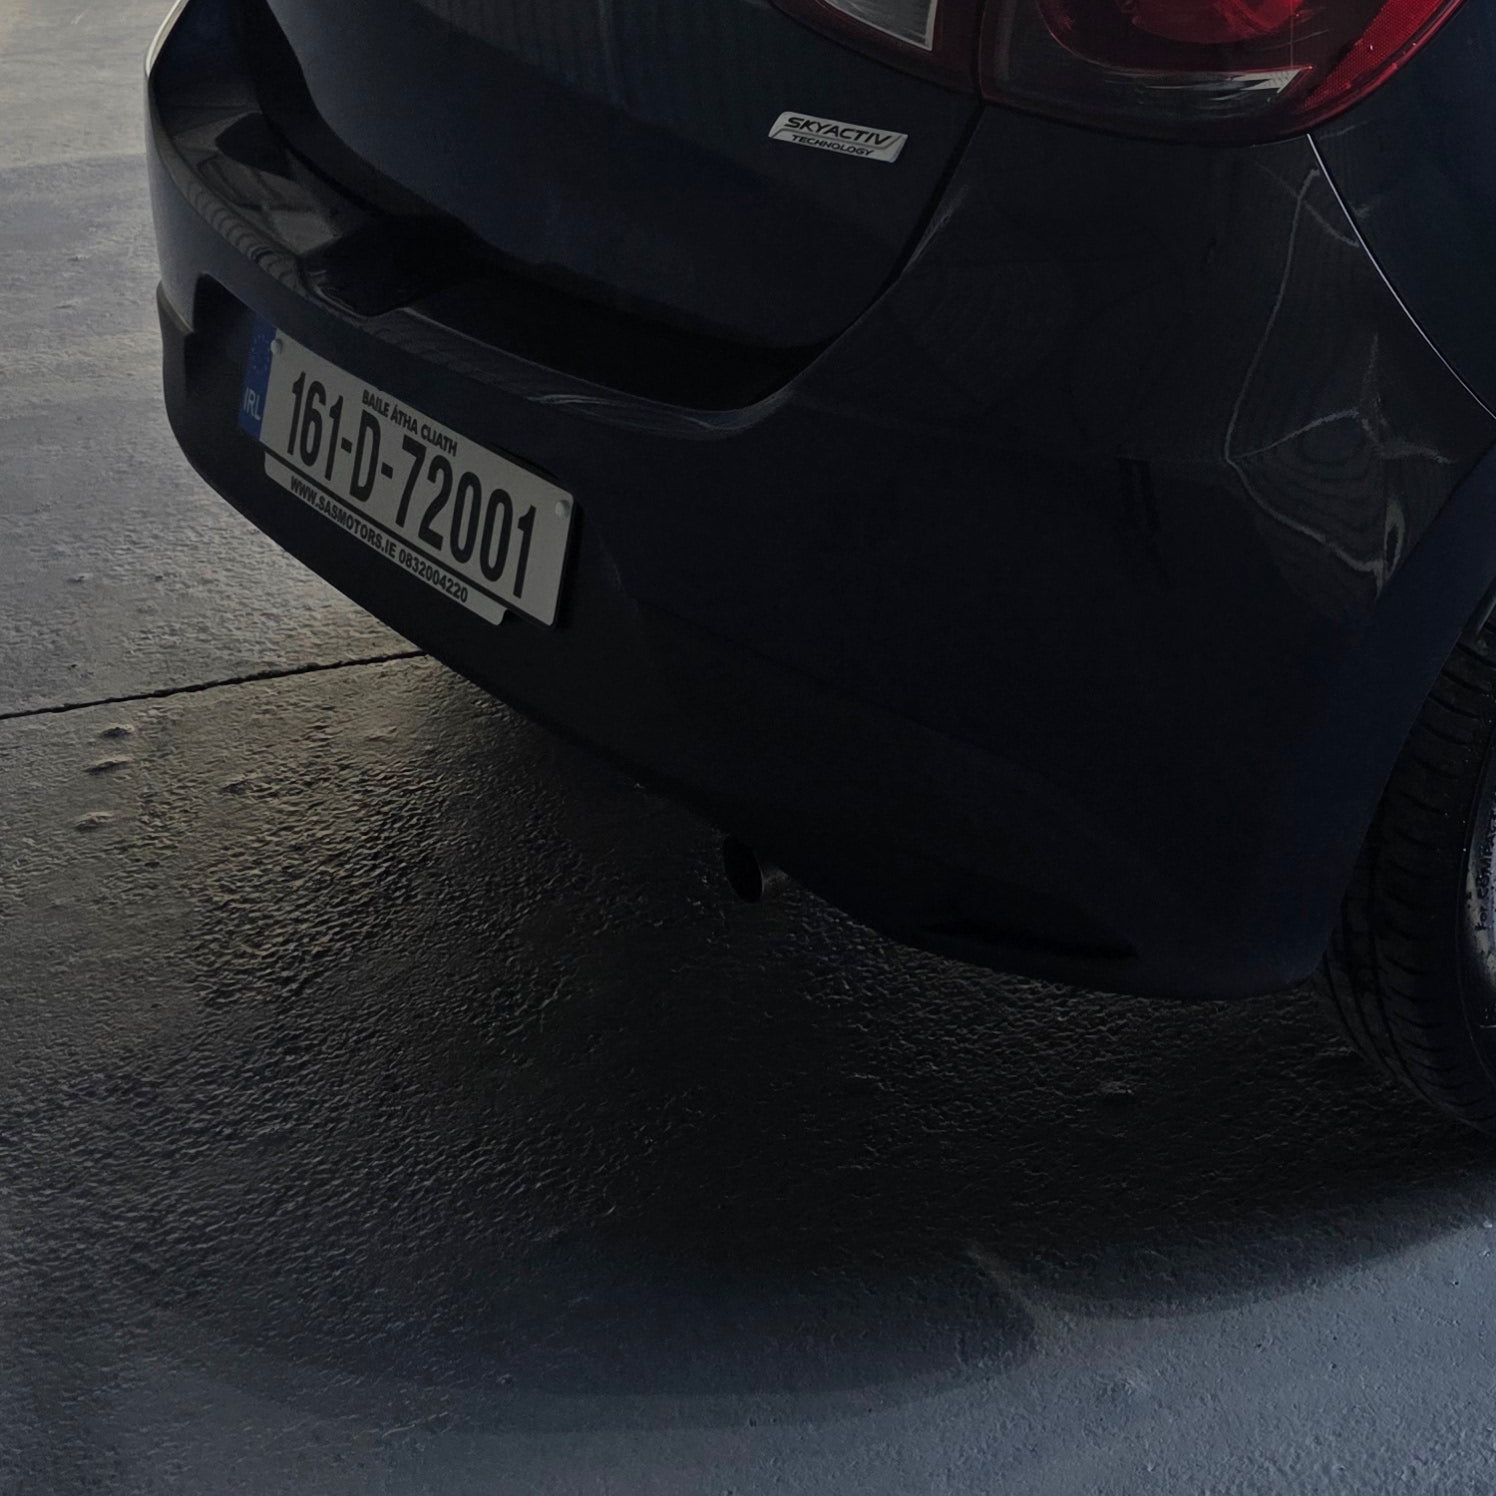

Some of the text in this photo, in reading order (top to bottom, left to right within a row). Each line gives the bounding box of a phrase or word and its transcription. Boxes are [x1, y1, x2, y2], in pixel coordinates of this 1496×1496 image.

[785, 116, 892, 145] SKYACTIV
[791, 134, 875, 156] TECHNOLOGY
[243, 387, 261, 421] IRL
[362, 389, 389, 419] BAILE
[420, 423, 458, 456] CLIATH
[287, 371, 537, 599] 161-D-72001
[290, 475, 468, 604] WWW.SASMOTORS.IE 0832004220
